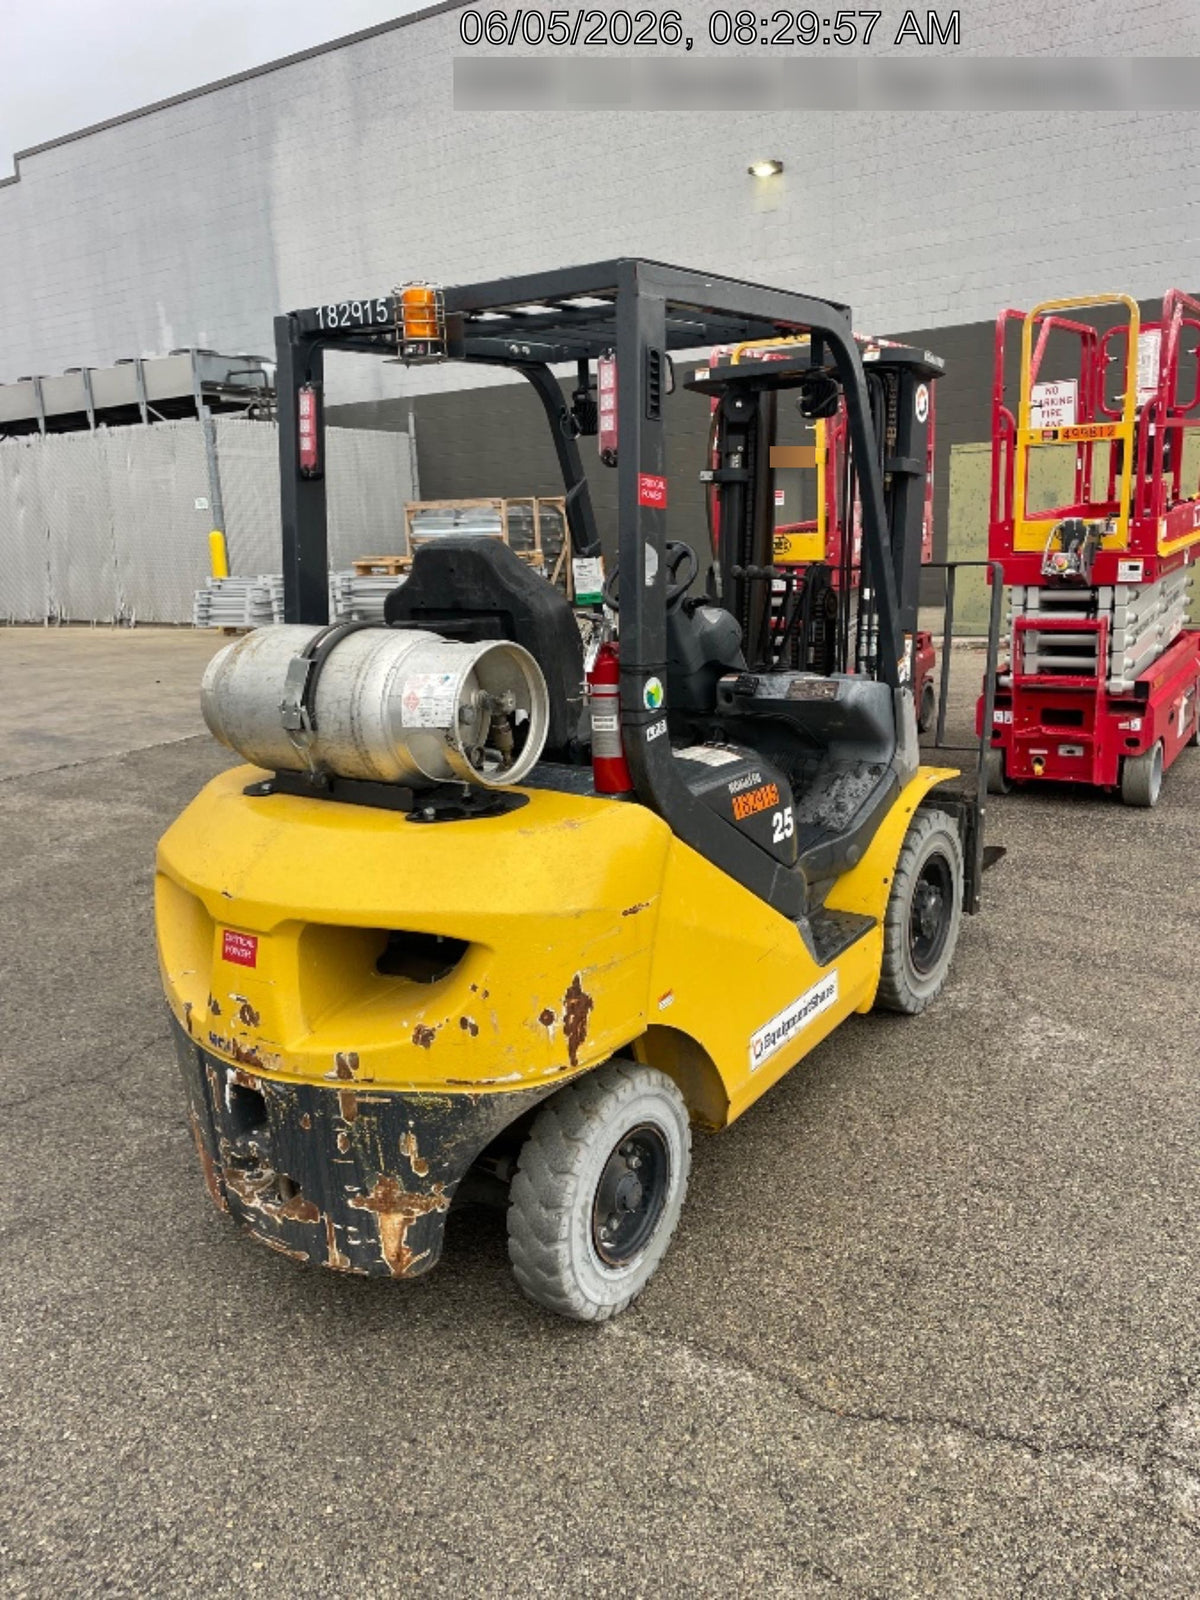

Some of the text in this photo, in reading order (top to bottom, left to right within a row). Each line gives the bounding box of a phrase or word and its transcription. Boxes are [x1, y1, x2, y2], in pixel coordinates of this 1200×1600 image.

[316, 298, 388, 329] 182915
[1044, 385, 1059, 396] NO
[1041, 408, 1062, 418] FIRE
[772, 806, 794, 844] 25
